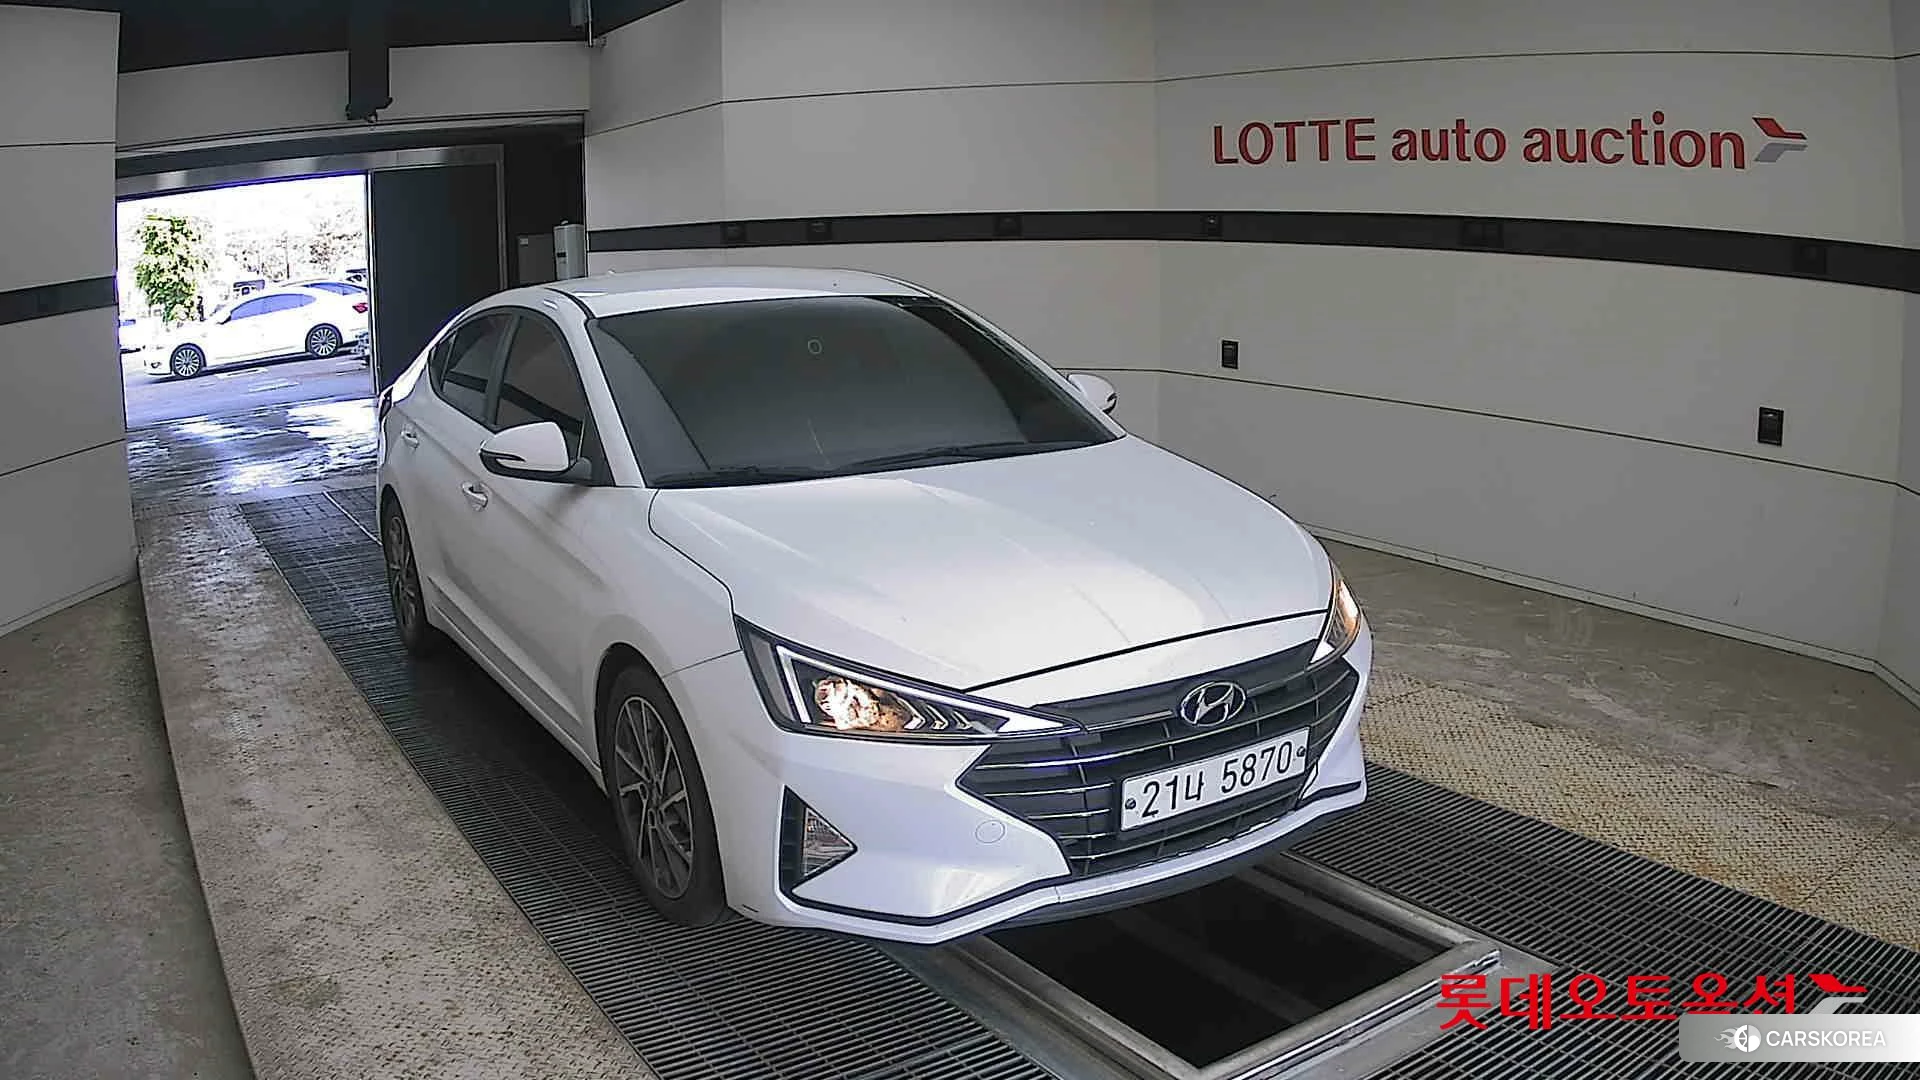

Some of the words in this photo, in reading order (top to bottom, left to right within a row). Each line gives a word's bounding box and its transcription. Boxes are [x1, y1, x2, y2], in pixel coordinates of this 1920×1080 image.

[1213, 117, 1376, 165] LOTTE
[1391, 118, 1507, 163] auto
[1522, 111, 1746, 169] auction
[1141, 770, 1205, 818] 21나
[1220, 740, 1293, 794] 5870
